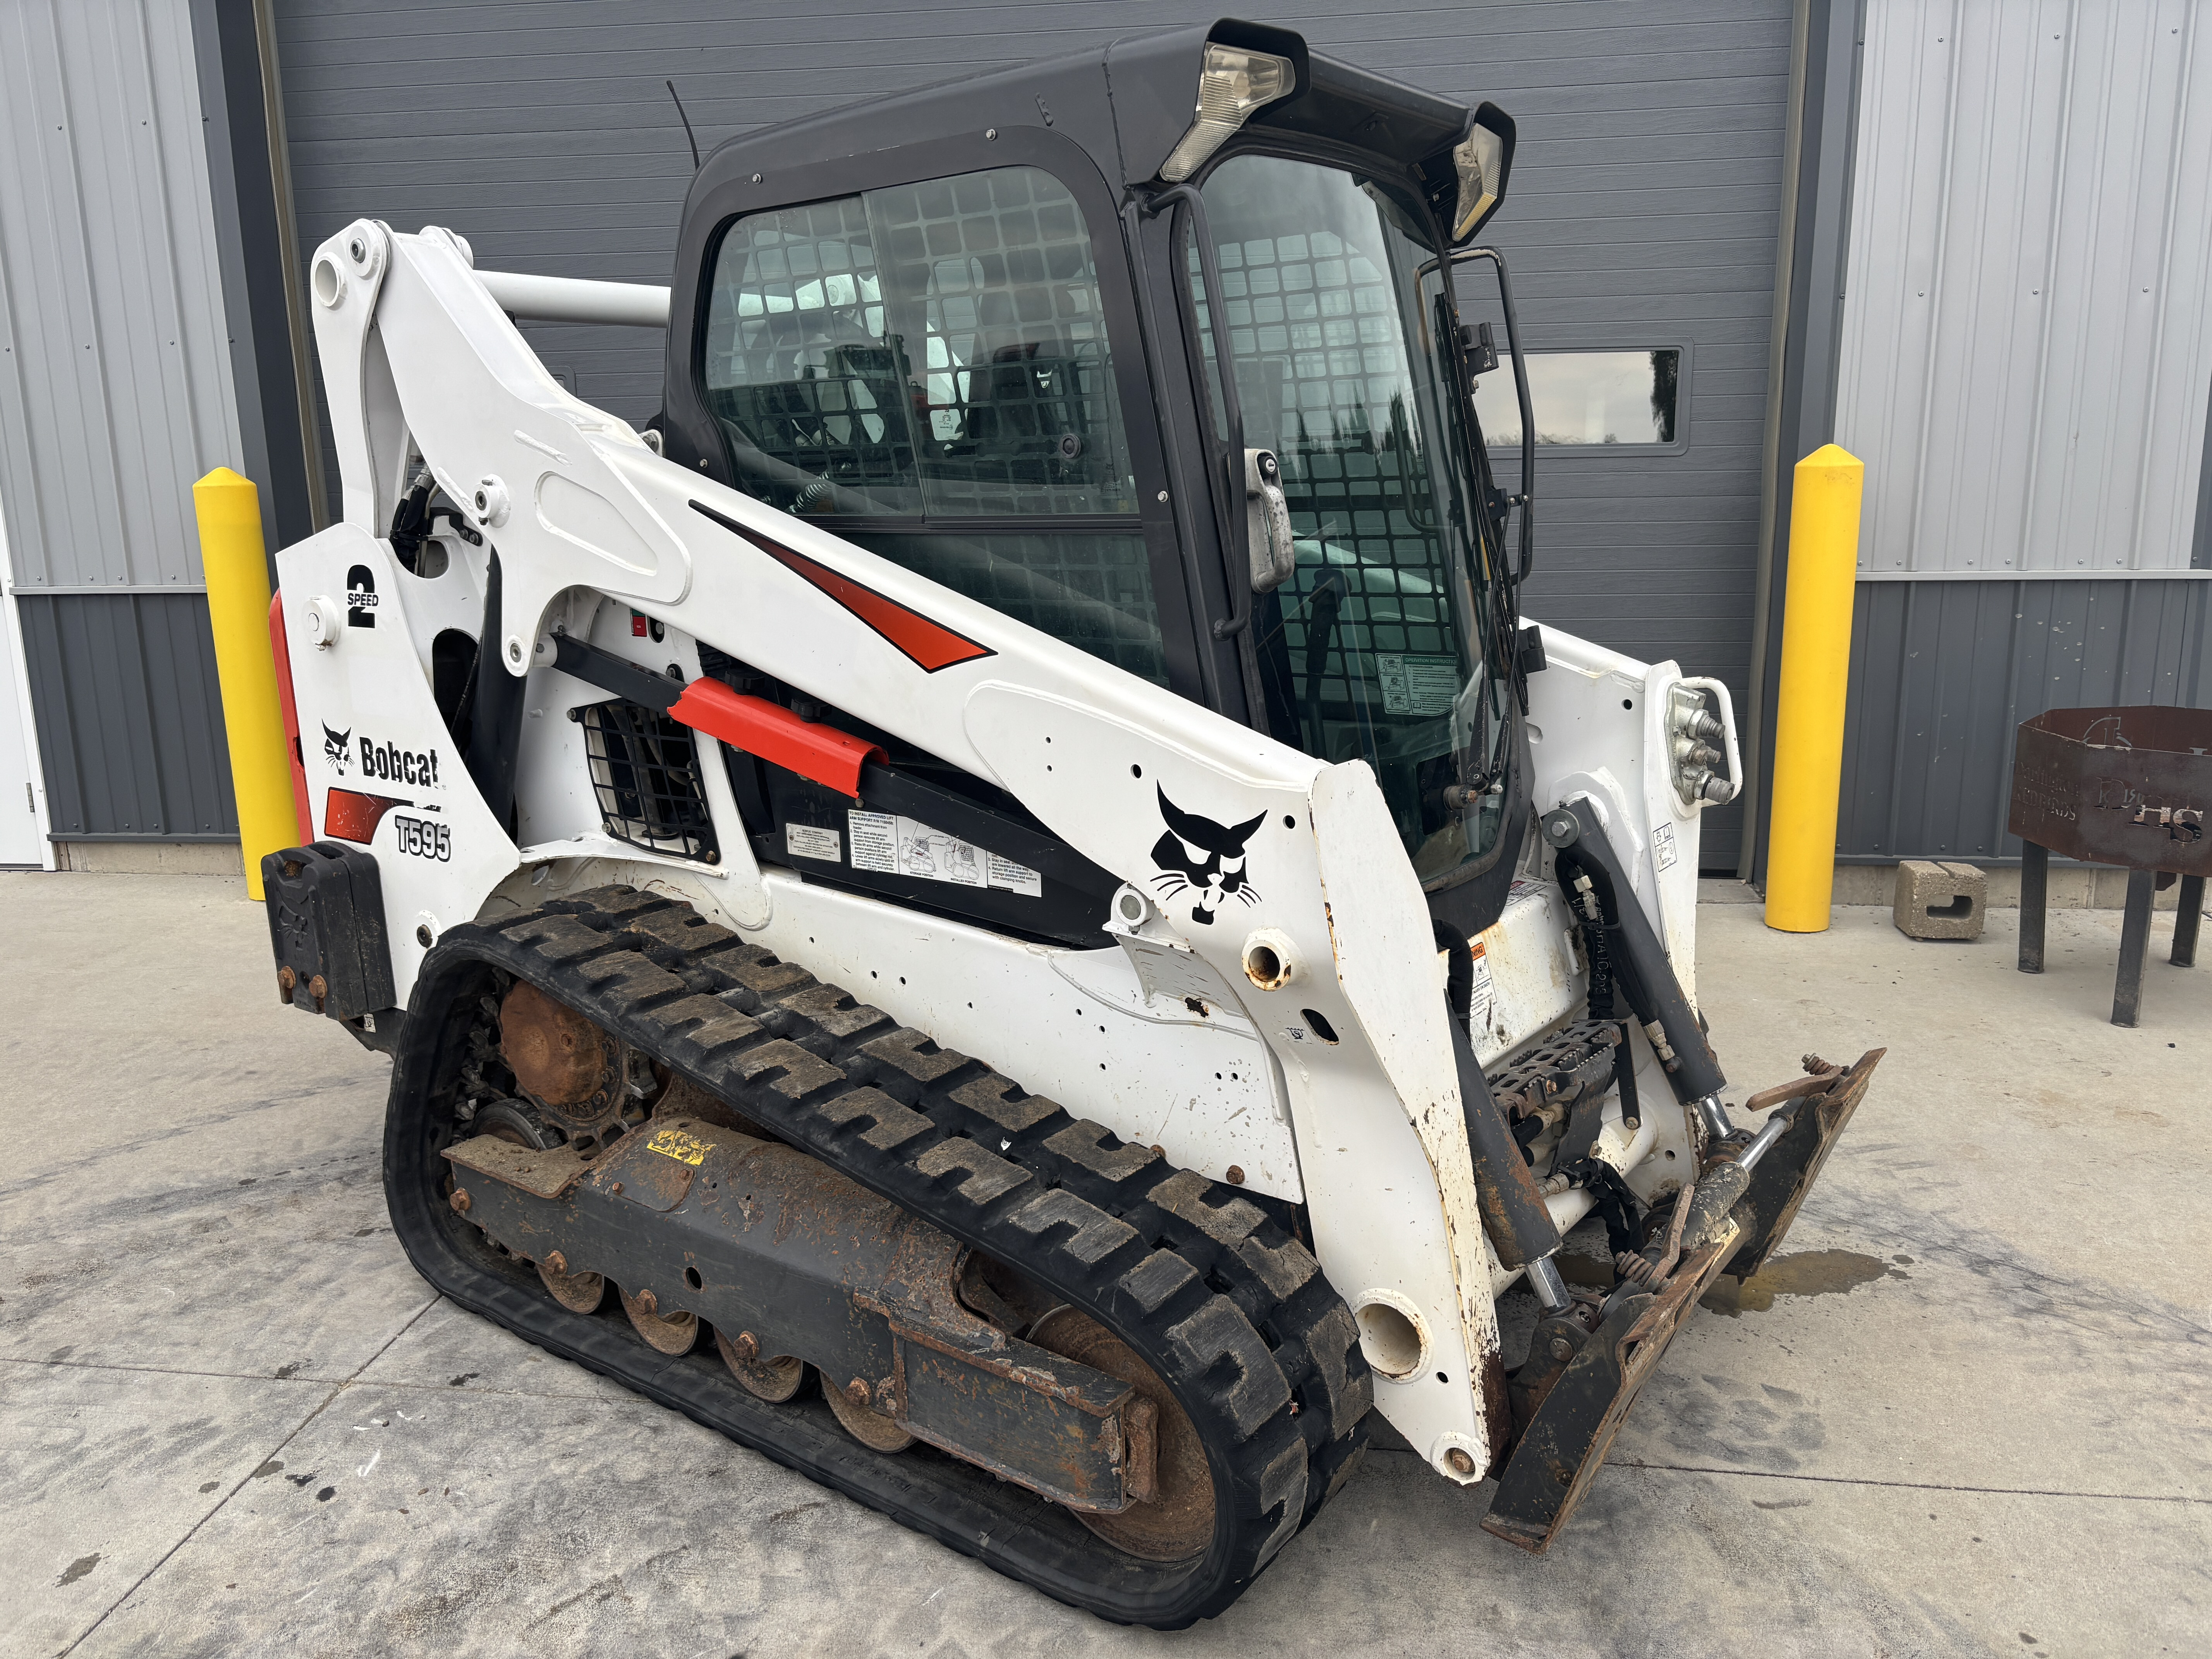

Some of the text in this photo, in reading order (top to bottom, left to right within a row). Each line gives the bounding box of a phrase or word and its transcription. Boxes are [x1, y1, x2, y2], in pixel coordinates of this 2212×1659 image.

[347, 565, 375, 629] 2
[347, 593, 378, 606] SPEED
[359, 737, 440, 789] Bobcat
[395, 815, 451, 862] T595
